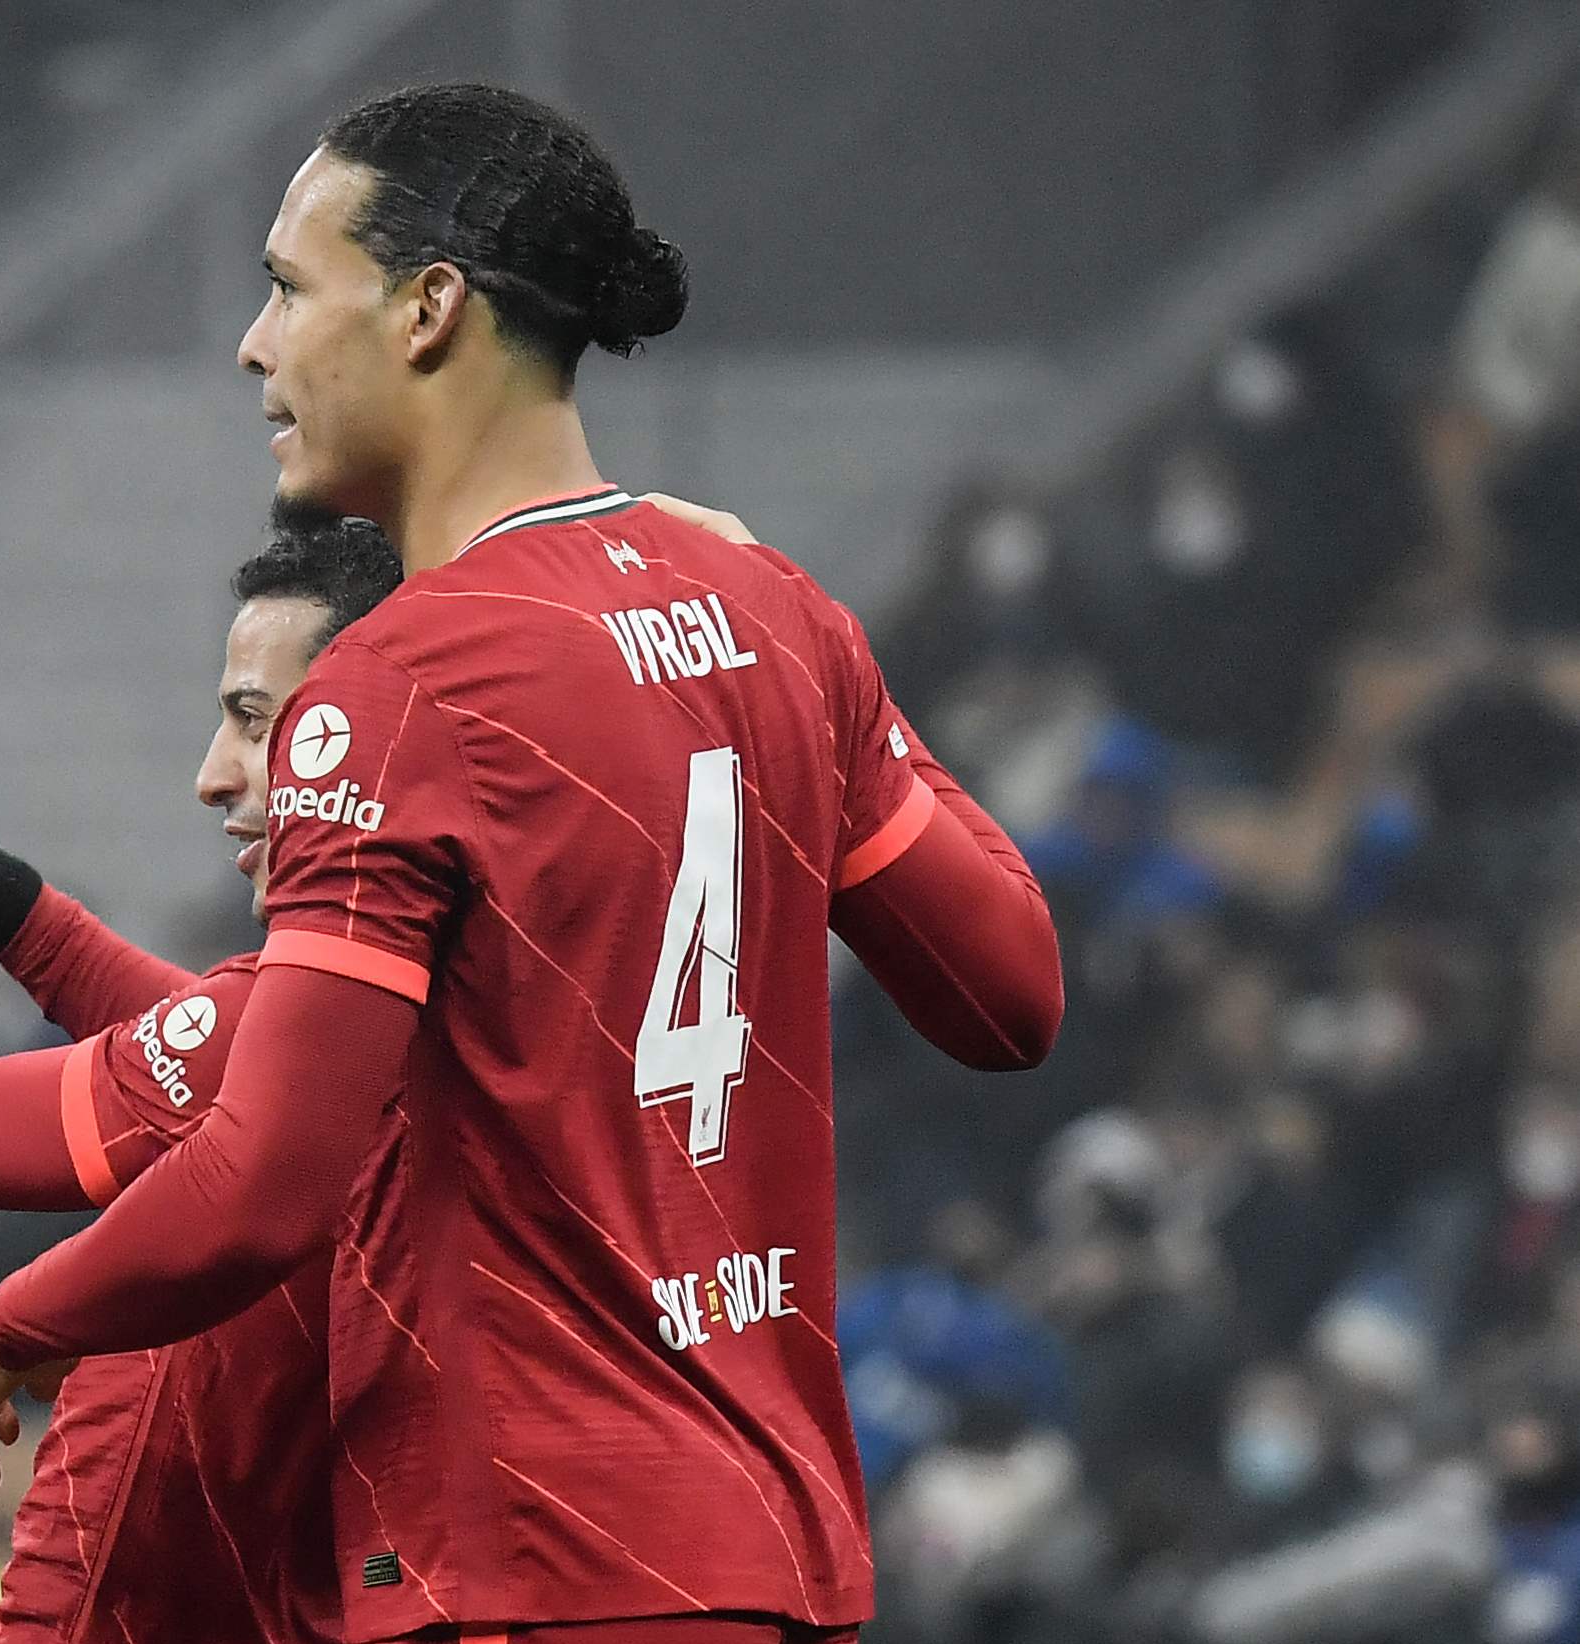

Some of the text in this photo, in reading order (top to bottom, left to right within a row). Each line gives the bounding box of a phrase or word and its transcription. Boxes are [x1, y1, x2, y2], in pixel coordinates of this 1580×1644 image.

[601, 594, 757, 687] VIRGIL
[635, 746, 752, 1168] 4
[717, 1248, 799, 1333] SIDE
